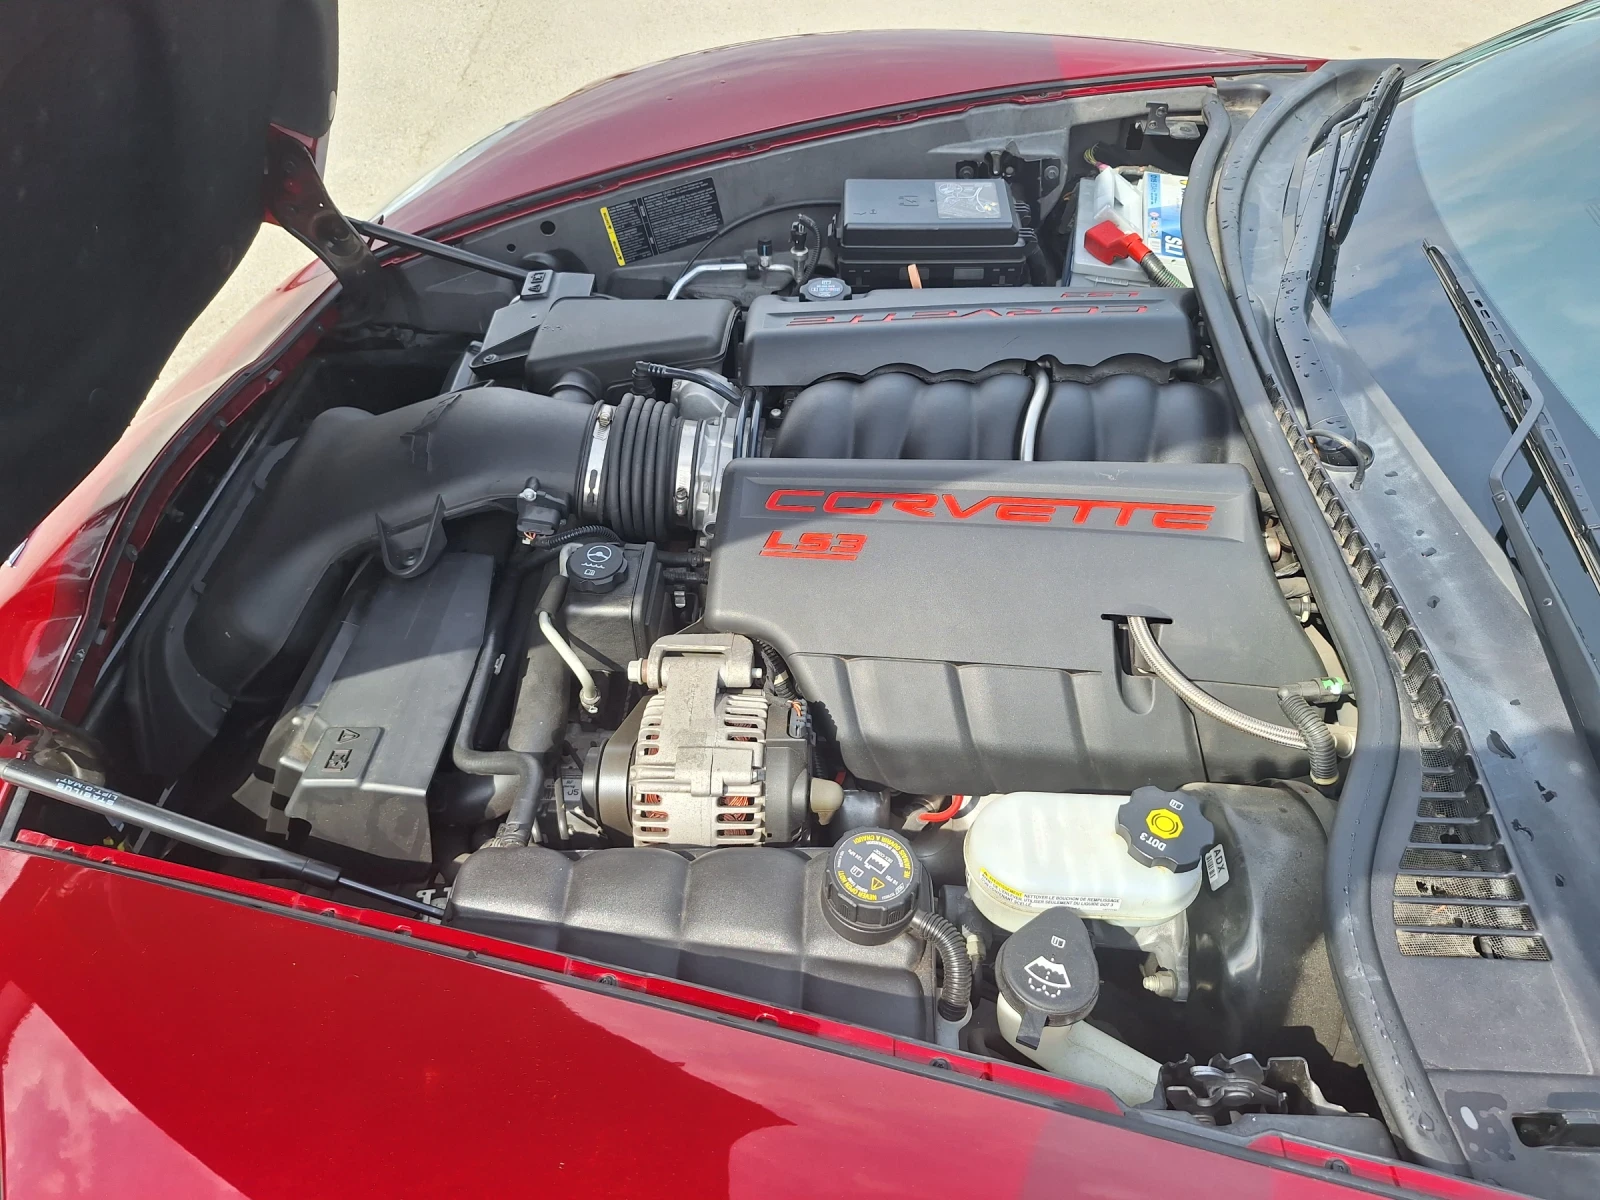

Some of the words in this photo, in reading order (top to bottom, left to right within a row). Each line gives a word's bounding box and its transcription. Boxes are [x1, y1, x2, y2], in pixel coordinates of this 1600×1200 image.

[786, 305, 1147, 326] CORVETTE
[764, 488, 1215, 530] CORVETTE
[763, 530, 868, 553] LS3
[57, 783, 114, 806] STABILUS
[1139, 832, 1148, 840] 3
[1145, 836, 1167, 851] DOT
[1213, 849, 1225, 873] ADX
[845, 882, 858, 895] OPEN
[858, 892, 877, 901] NEVER
